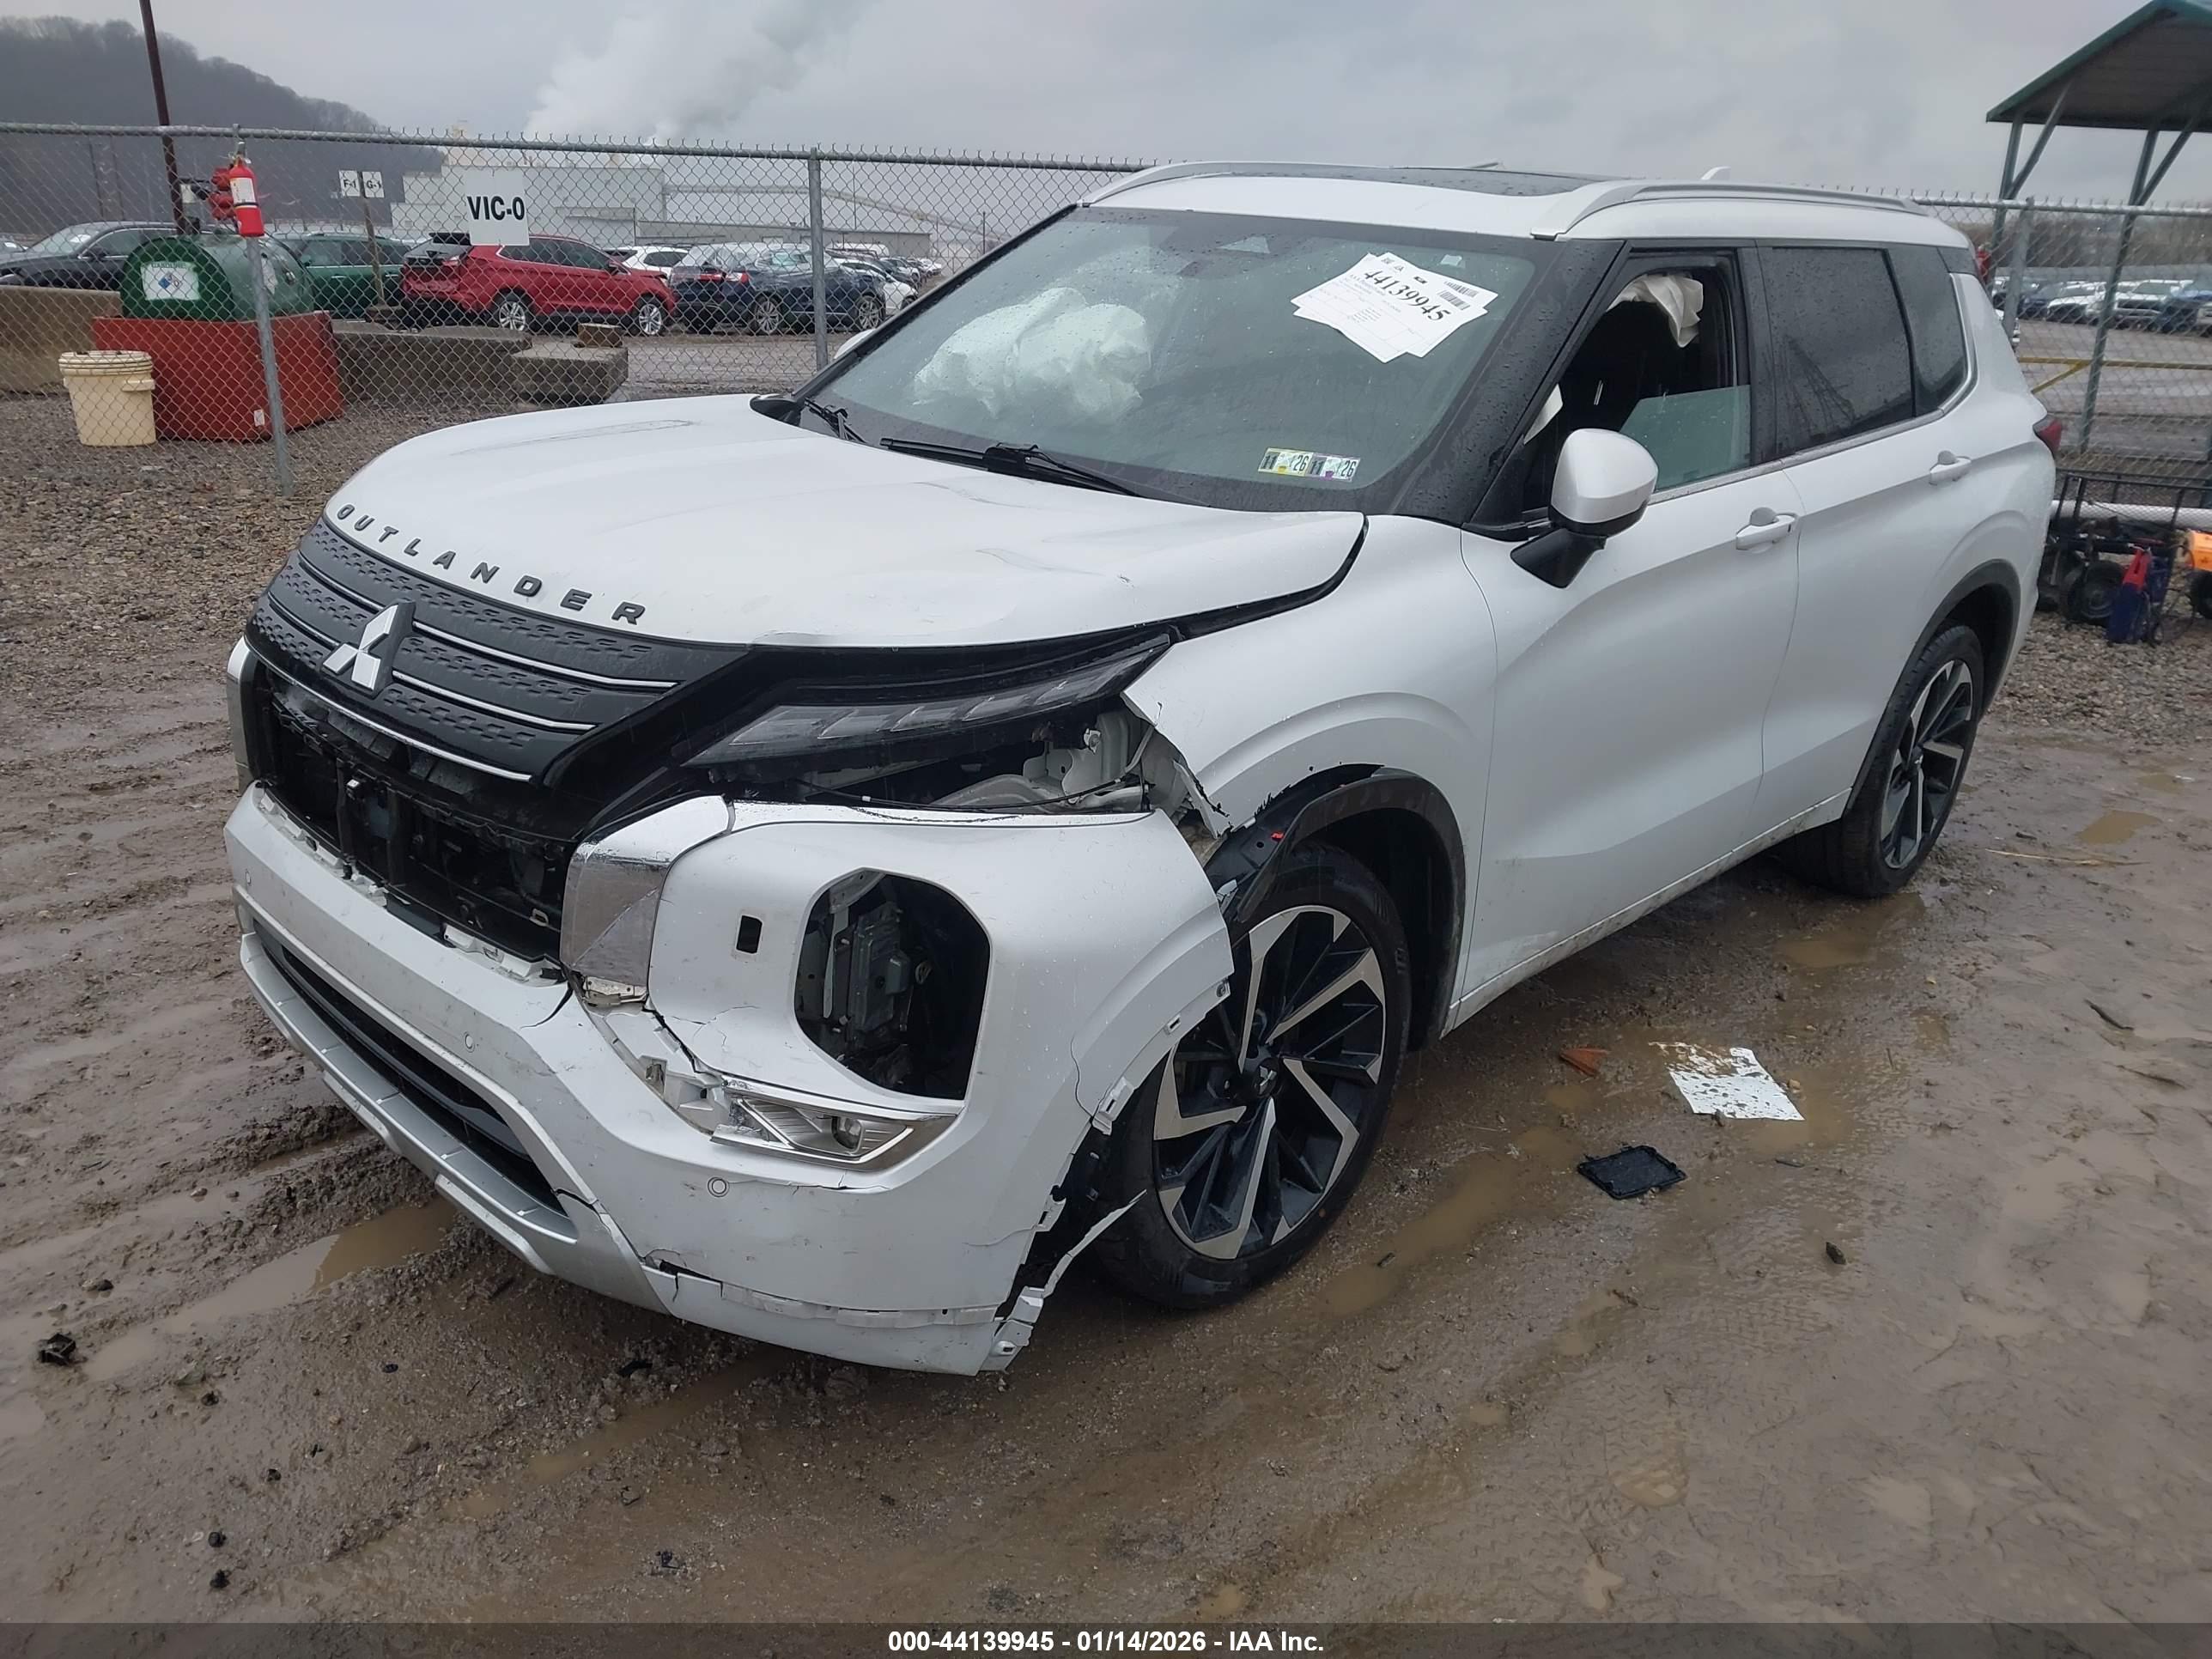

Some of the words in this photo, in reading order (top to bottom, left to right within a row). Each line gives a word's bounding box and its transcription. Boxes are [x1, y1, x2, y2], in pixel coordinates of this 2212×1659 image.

[1364, 270, 1451, 321] 44139945
[1262, 454, 1278, 470] 11
[1293, 454, 1310, 471] 26
[1310, 459, 1324, 475] 11
[1340, 459, 1357, 477] 26
[336, 503, 646, 625] OUTLANDER
